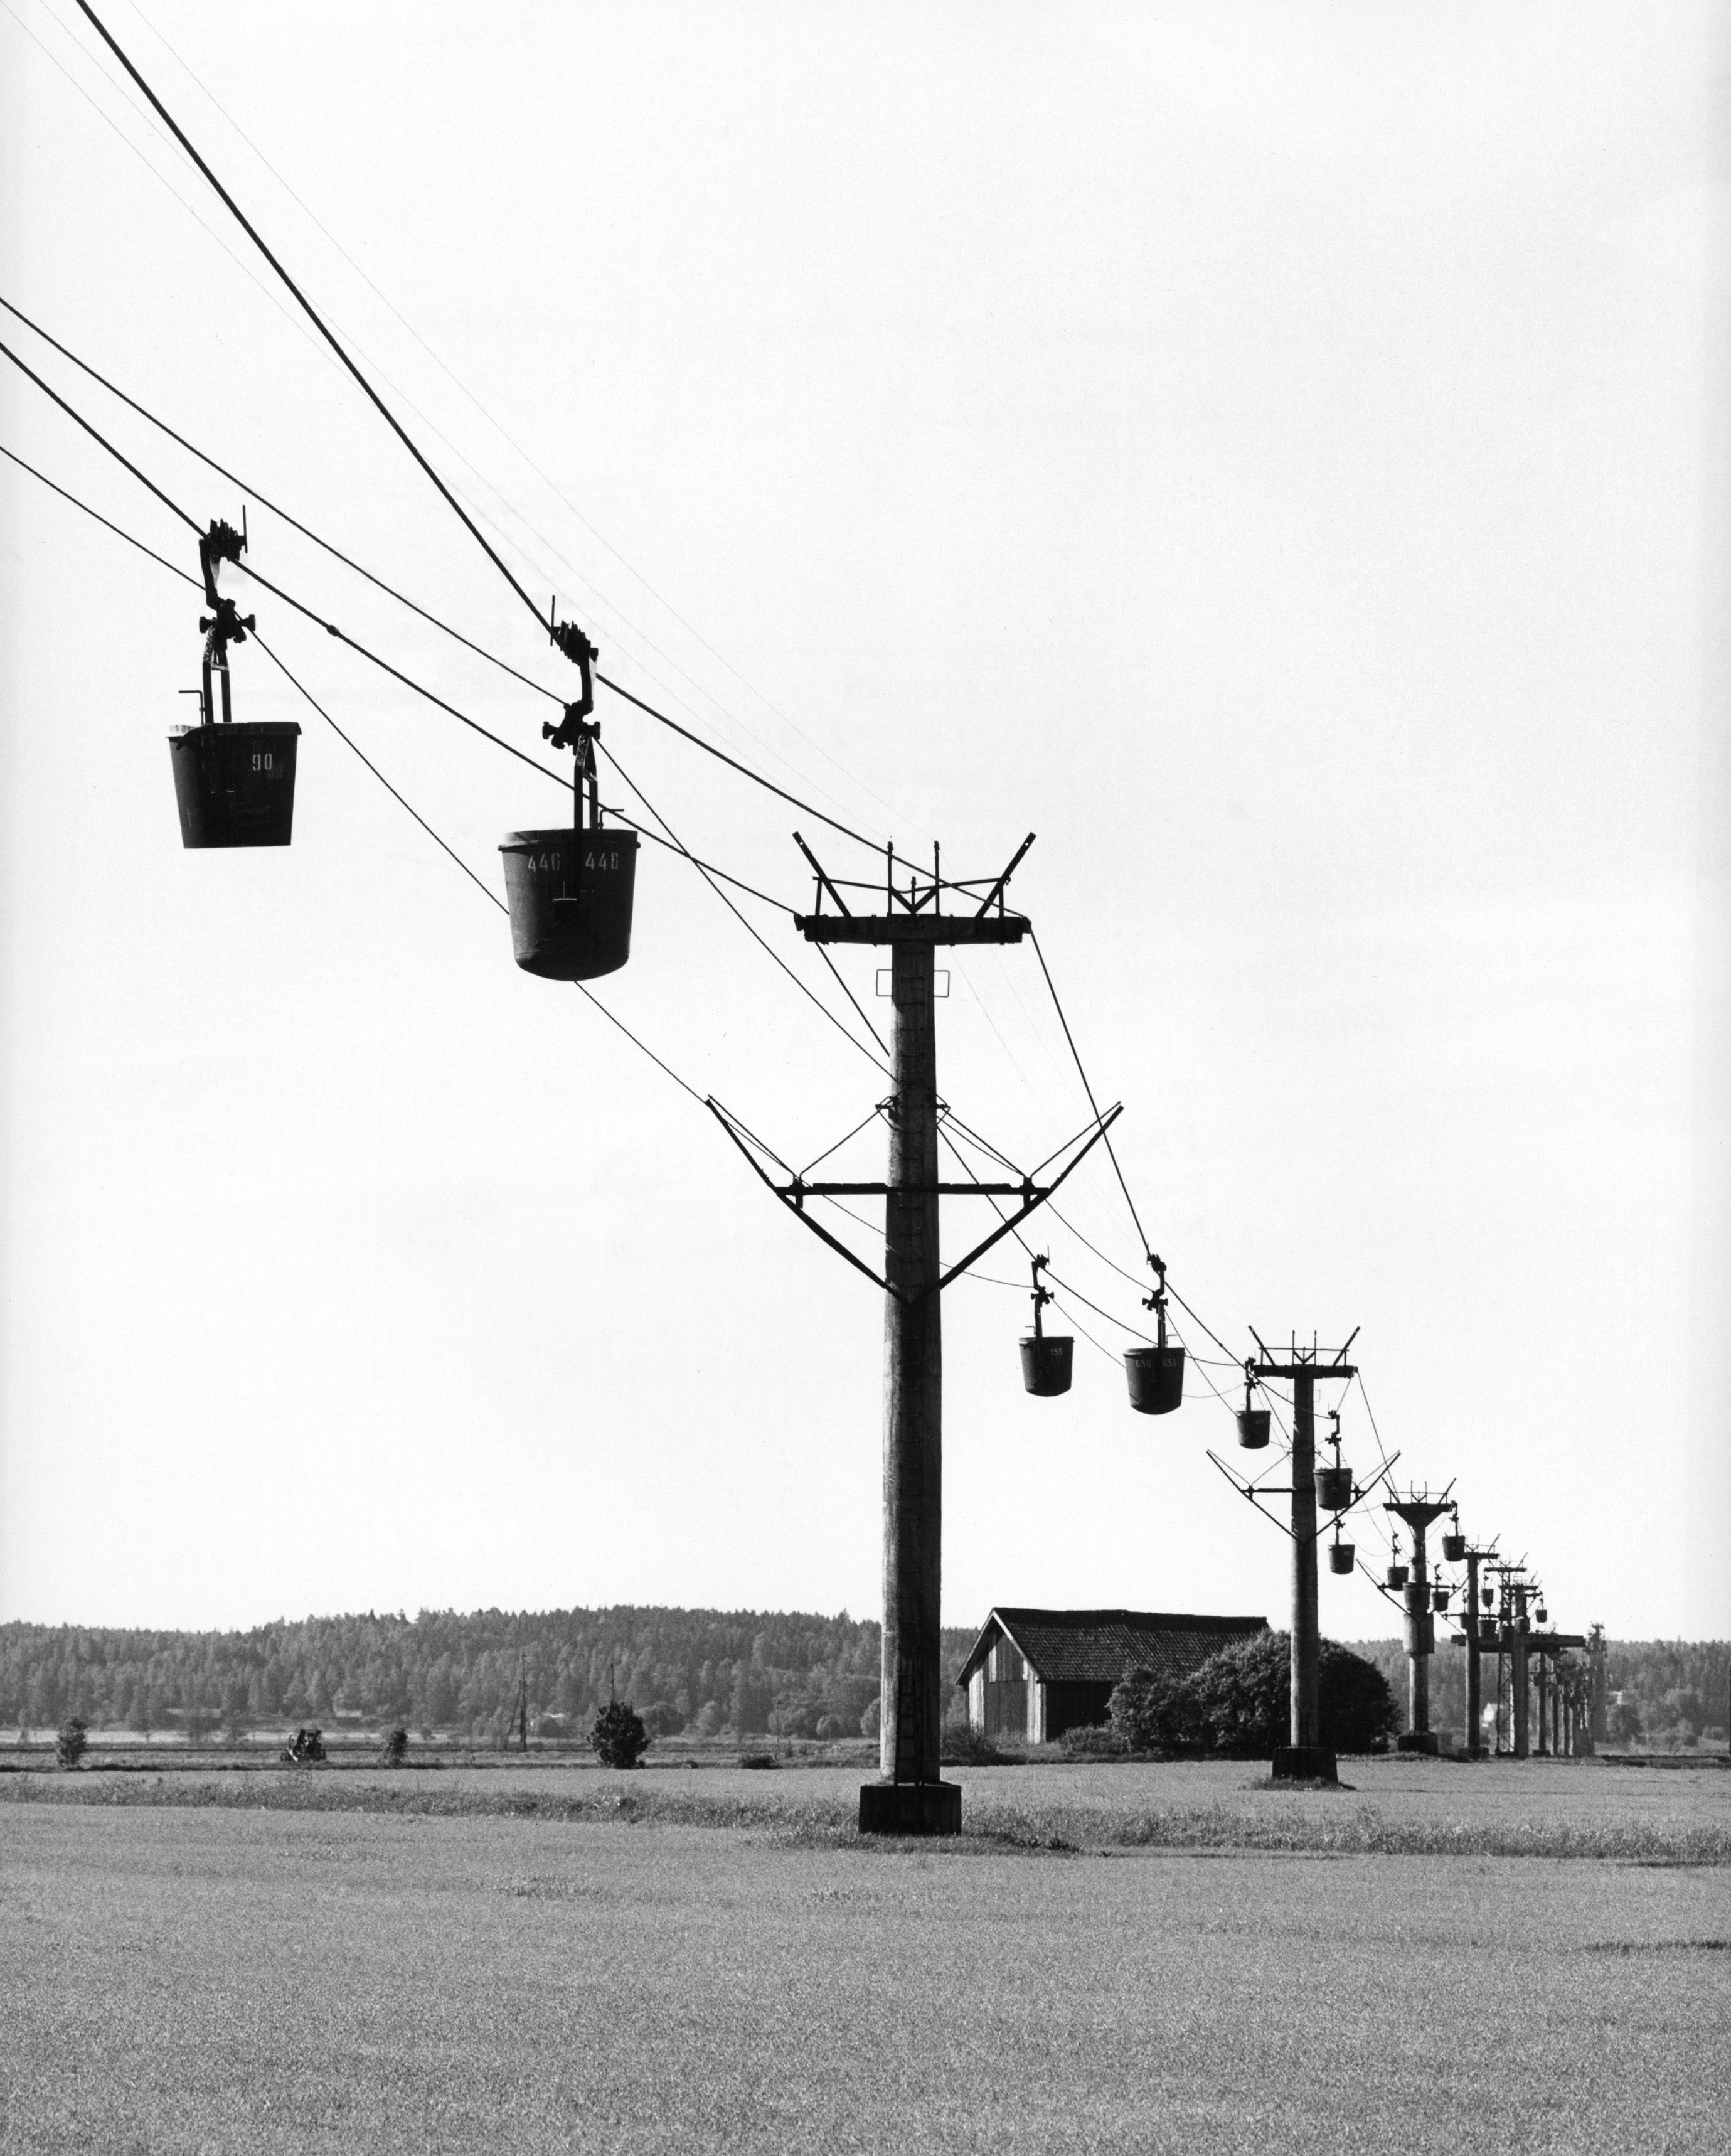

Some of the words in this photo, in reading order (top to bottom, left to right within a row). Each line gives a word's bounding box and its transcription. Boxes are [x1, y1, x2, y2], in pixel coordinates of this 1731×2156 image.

[252, 753, 272, 771] 90
[528, 853, 560, 872] 446
[585, 851, 619, 870] 446
